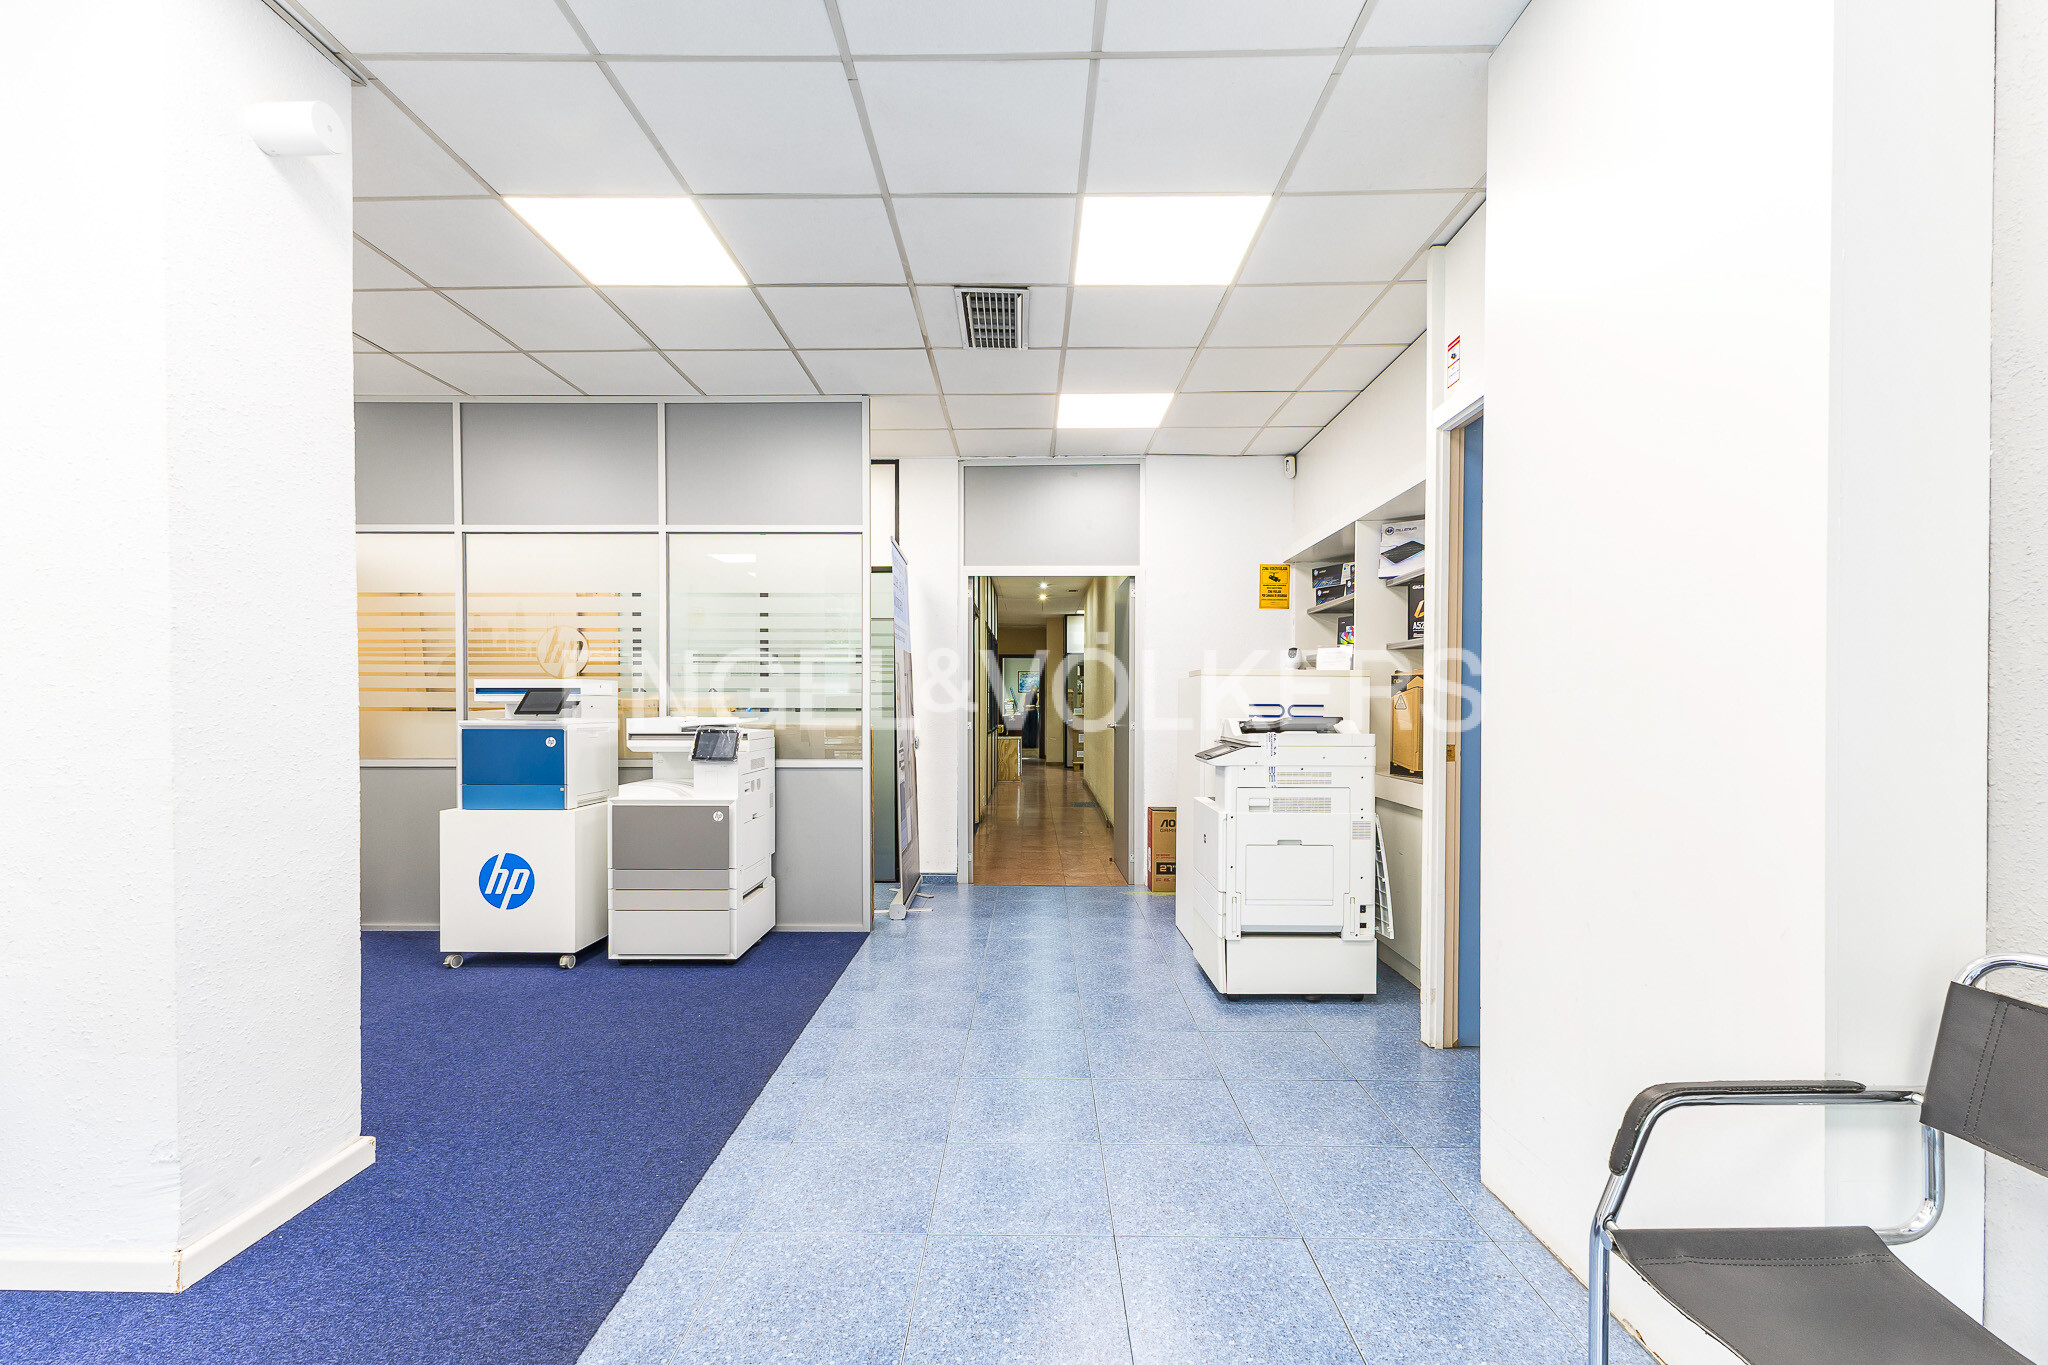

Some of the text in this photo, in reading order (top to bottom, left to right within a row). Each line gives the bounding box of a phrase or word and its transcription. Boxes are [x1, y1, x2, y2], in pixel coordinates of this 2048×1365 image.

[545, 737, 556, 748] hp
[713, 811, 724, 823] hp
[484, 853, 531, 910] hp
